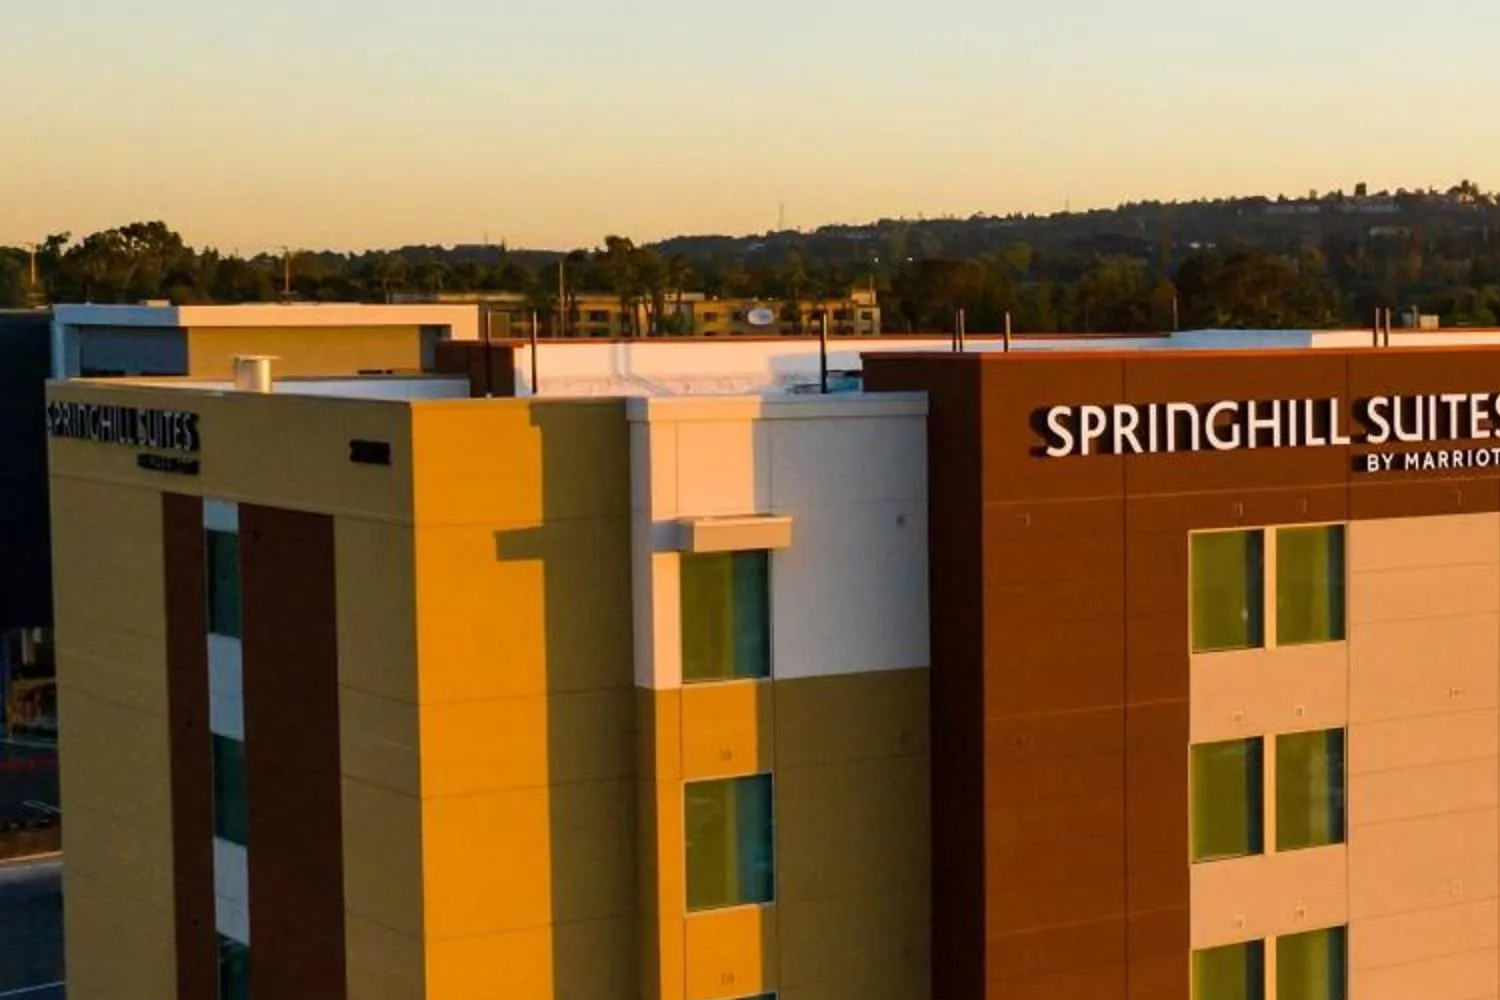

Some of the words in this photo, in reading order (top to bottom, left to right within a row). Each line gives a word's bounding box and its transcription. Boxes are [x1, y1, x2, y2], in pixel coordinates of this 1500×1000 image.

[136, 409, 195, 451] SUITES
[1045, 397, 1351, 458] SPRINGHILL
[1366, 452, 1395, 473] BY
